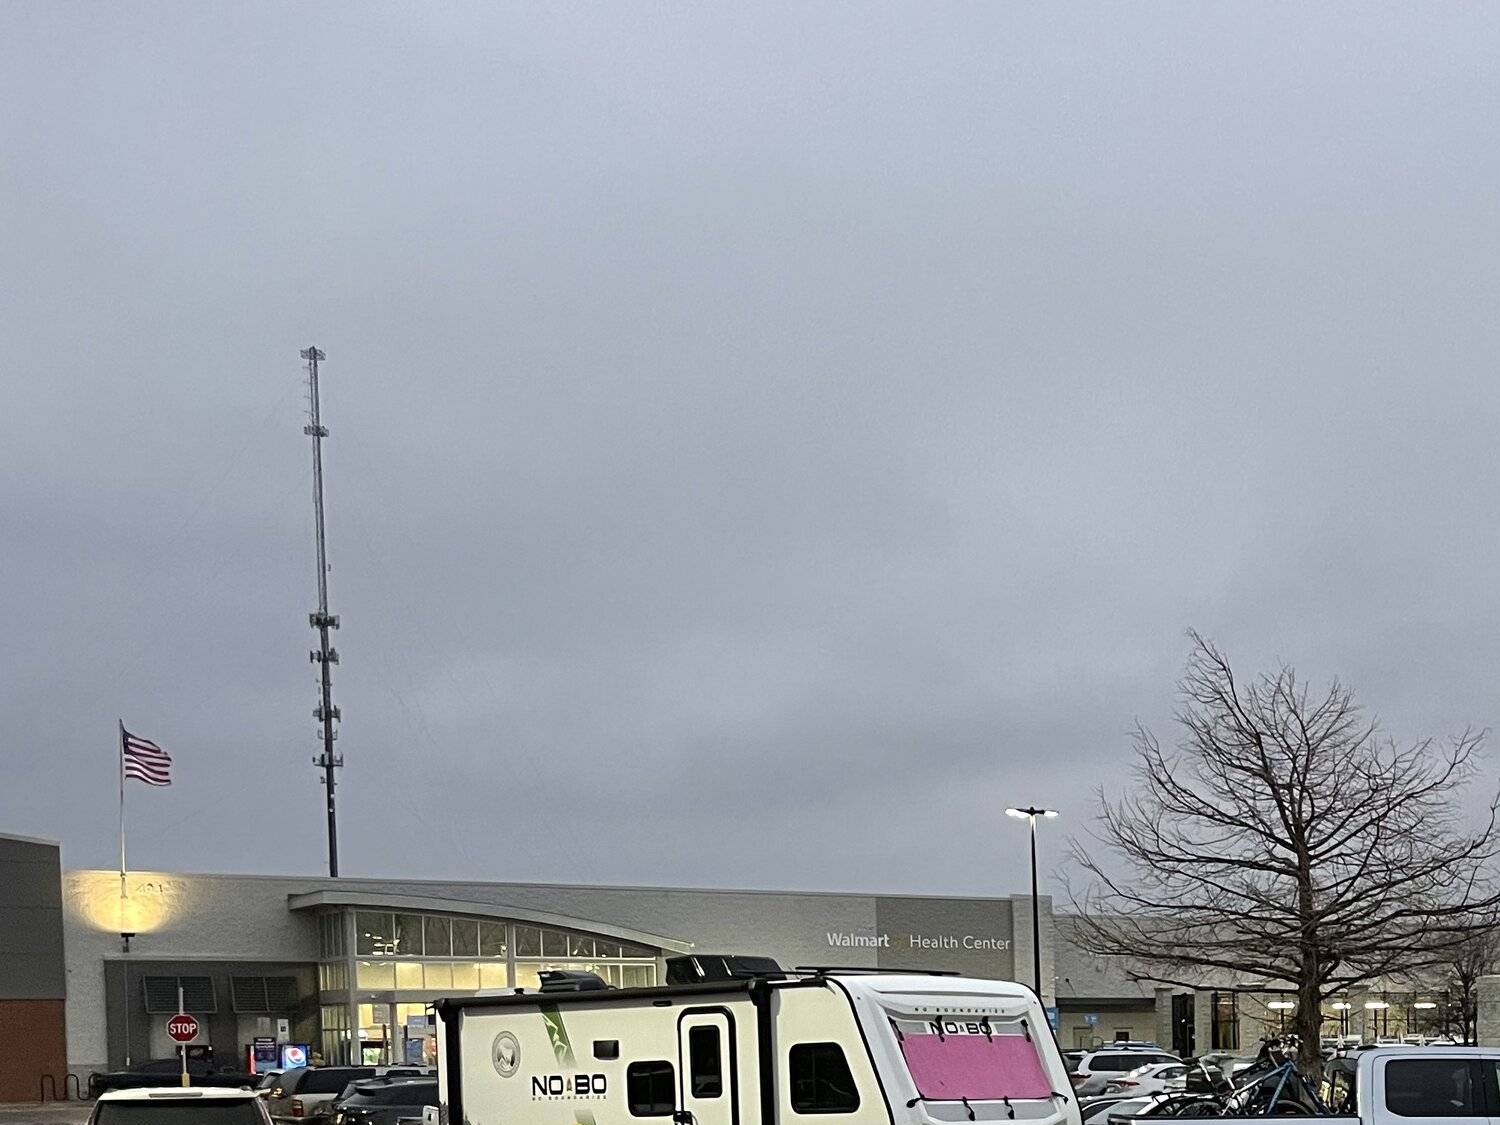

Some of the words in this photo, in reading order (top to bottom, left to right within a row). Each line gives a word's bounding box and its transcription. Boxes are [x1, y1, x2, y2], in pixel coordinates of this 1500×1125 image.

[827, 933, 890, 948] Walmart
[910, 934, 958, 950] Health
[962, 935, 1011, 950] Center
[169, 1023, 197, 1034] STOP
